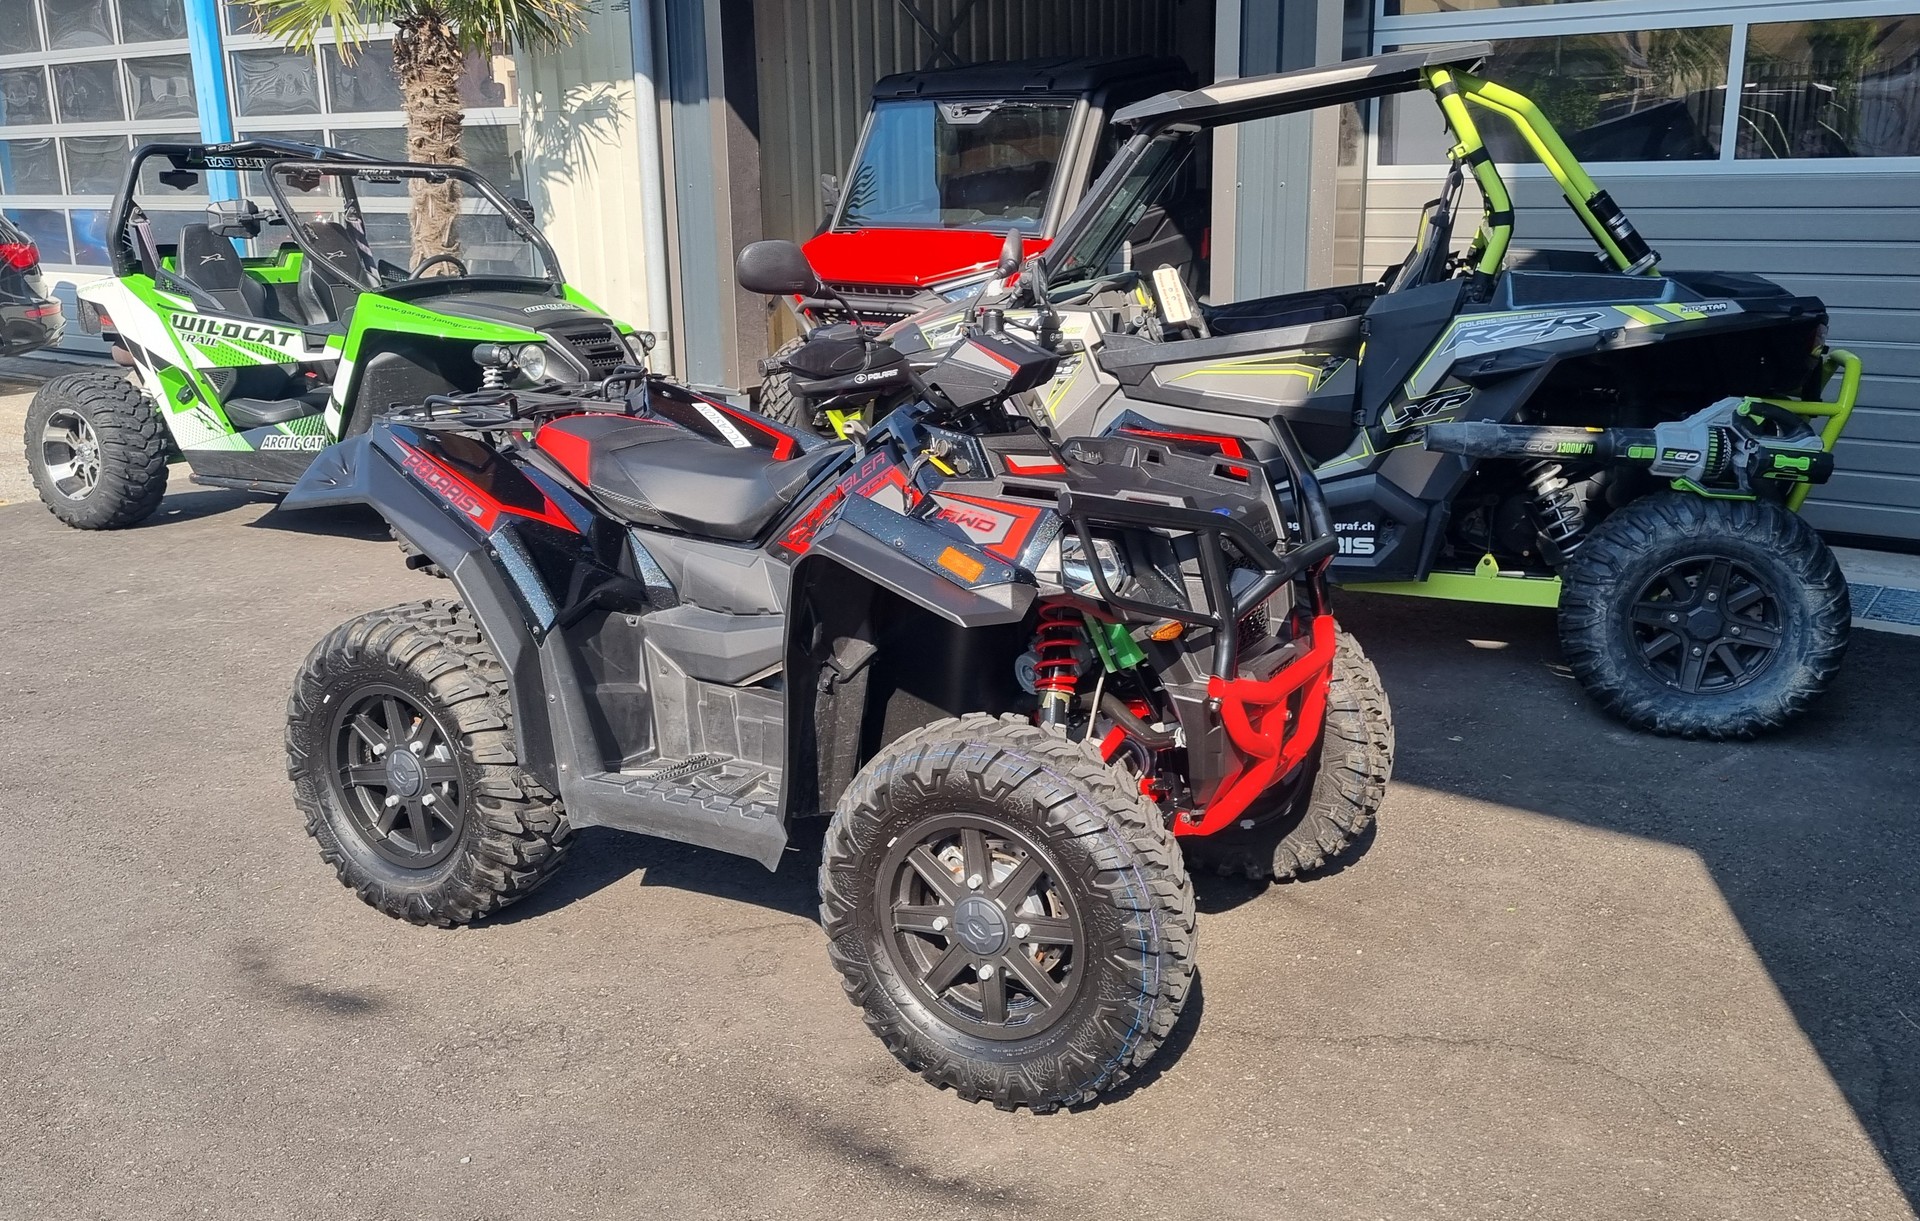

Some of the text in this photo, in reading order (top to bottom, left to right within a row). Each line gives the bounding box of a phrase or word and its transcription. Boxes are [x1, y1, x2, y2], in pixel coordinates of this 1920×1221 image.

[171, 313, 295, 347] WILDCAT
[1440, 311, 1606, 356] RZR
[1460, 319, 1497, 328] POLARIS
[180, 333, 218, 347] TRAIL
[867, 368, 899, 381] POLARIS
[1387, 391, 1473, 427] XP
[698, 405, 746, 447] OCCASION
[262, 435, 324, 450] ARCTIC CAT
[1663, 450, 1701, 461] EGO
[401, 453, 479, 513] POLARIS
